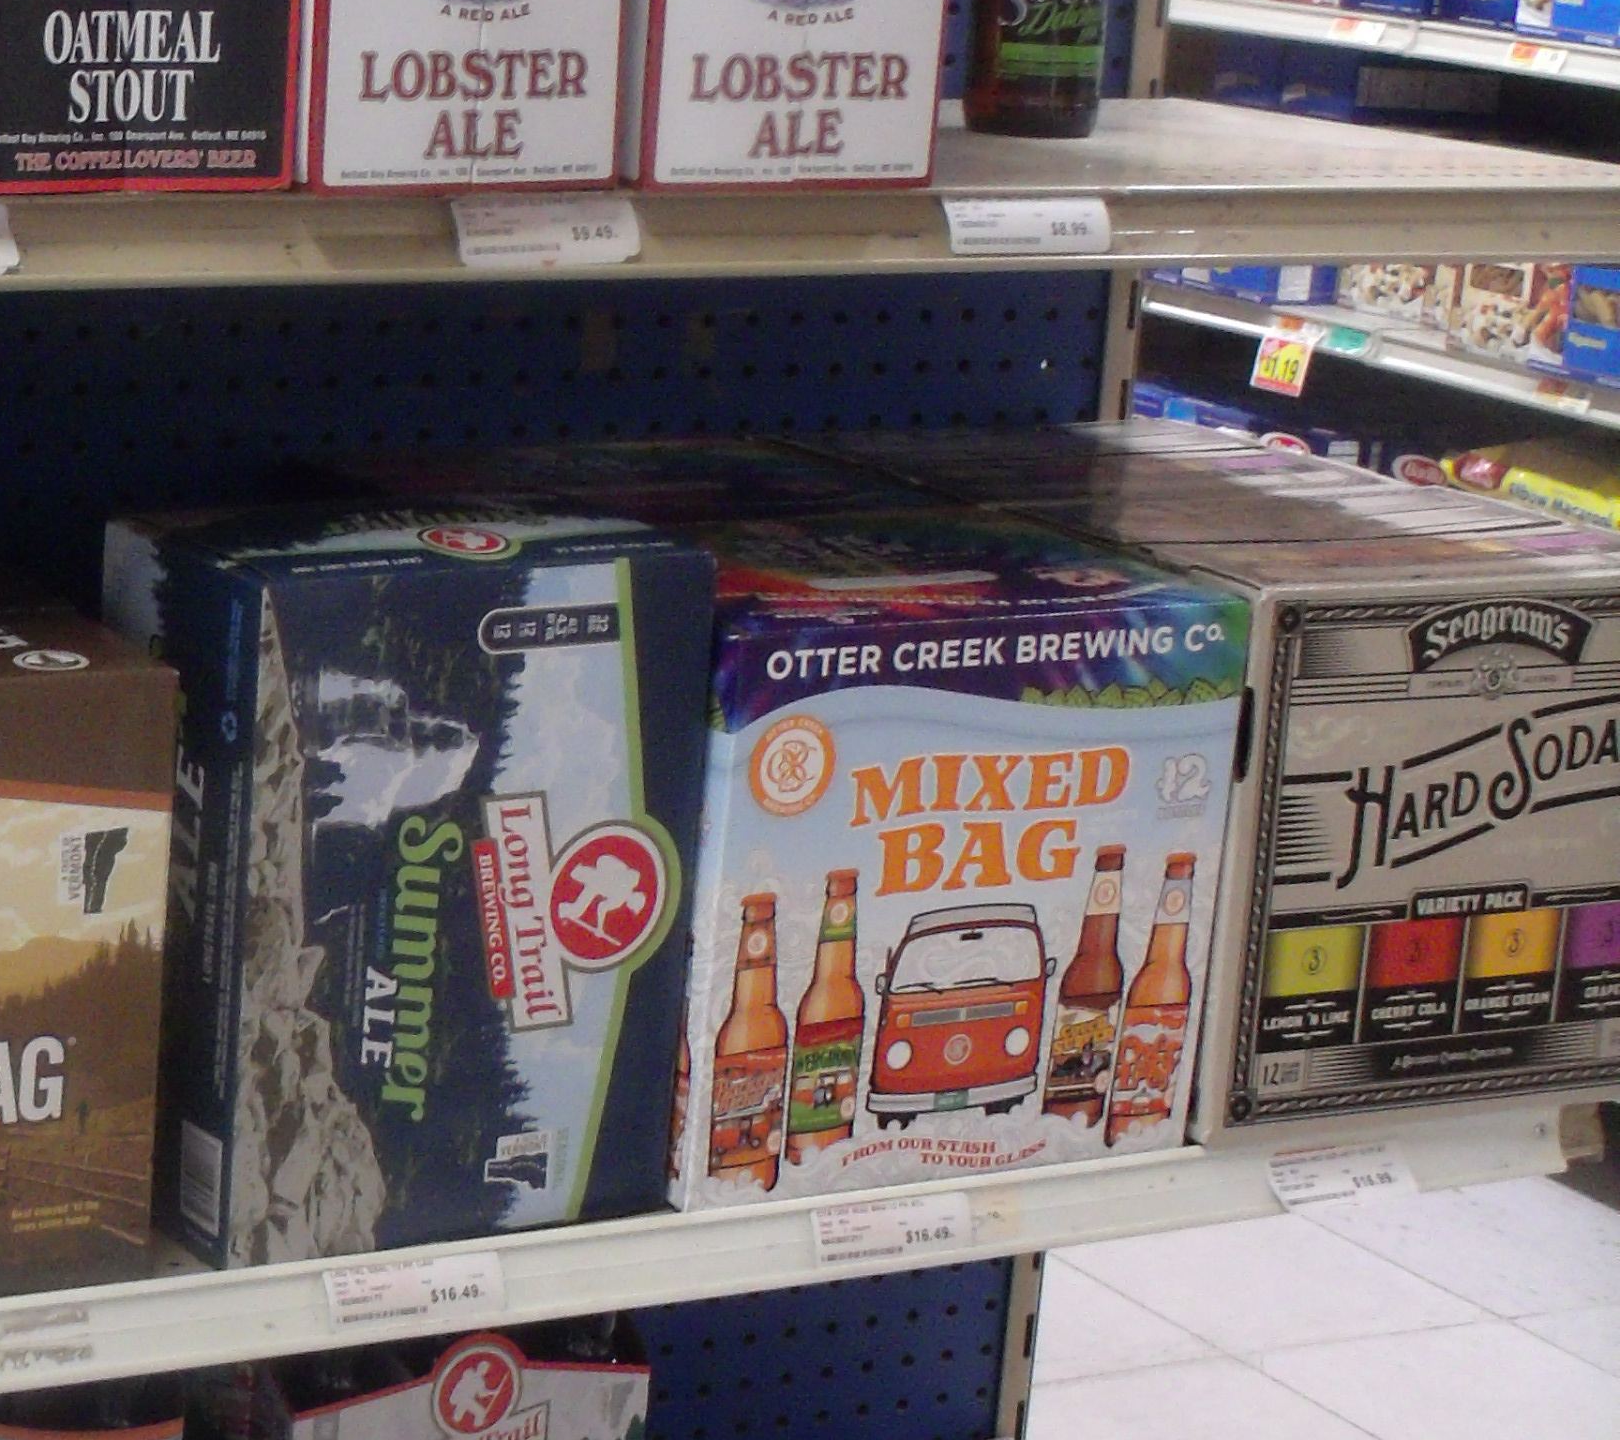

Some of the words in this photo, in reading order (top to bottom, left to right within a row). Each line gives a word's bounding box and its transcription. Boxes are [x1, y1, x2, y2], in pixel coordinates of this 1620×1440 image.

[43, 10, 221, 65] OATMEAL
[440, 4, 451, 16] A
[458, 7, 495, 22] RED
[500, 3, 530, 20] ALE
[767, 9, 778, 21] A
[784, 12, 818, 25] RED
[823, 7, 855, 24] ALE
[68, 69, 195, 123] STOUT
[359, 48, 589, 103] LOBSTER
[689, 51, 911, 103] LOBSTER
[423, 109, 524, 160] ALE
[748, 108, 845, 160] ALE
[14, 152, 51, 172] THE
[55, 151, 122, 171] COFFEE
[207, 149, 257, 168] BEER
[766, 644, 880, 681] OTTER
[893, 636, 1005, 670] CREEK
[1015, 627, 1173, 663] BREWING
[1422, 607, 1572, 659] Seagram's
[850, 745, 1131, 828] MIXED
[499, 806, 534, 910] Long
[875, 818, 1079, 898] BAG
[479, 854, 502, 948] BREWING
[491, 953, 508, 984] CO.
[1417, 894, 1480, 917] VARIETY
[1484, 890, 1524, 910] PACK
[381, 816, 463, 1121] Summer
[516, 916, 562, 1019] Trail
[361, 965, 397, 1068] ALE
[1417, 1002, 1447, 1016] COLA
[840, 1139, 894, 1167] FROM
[897, 1137, 932, 1152] OUR
[937, 1139, 997, 1155] STASH
[920, 1152, 942, 1165] TO
[945, 1152, 991, 1167] YOUR
[430, 1284, 479, 1303] $16.49
